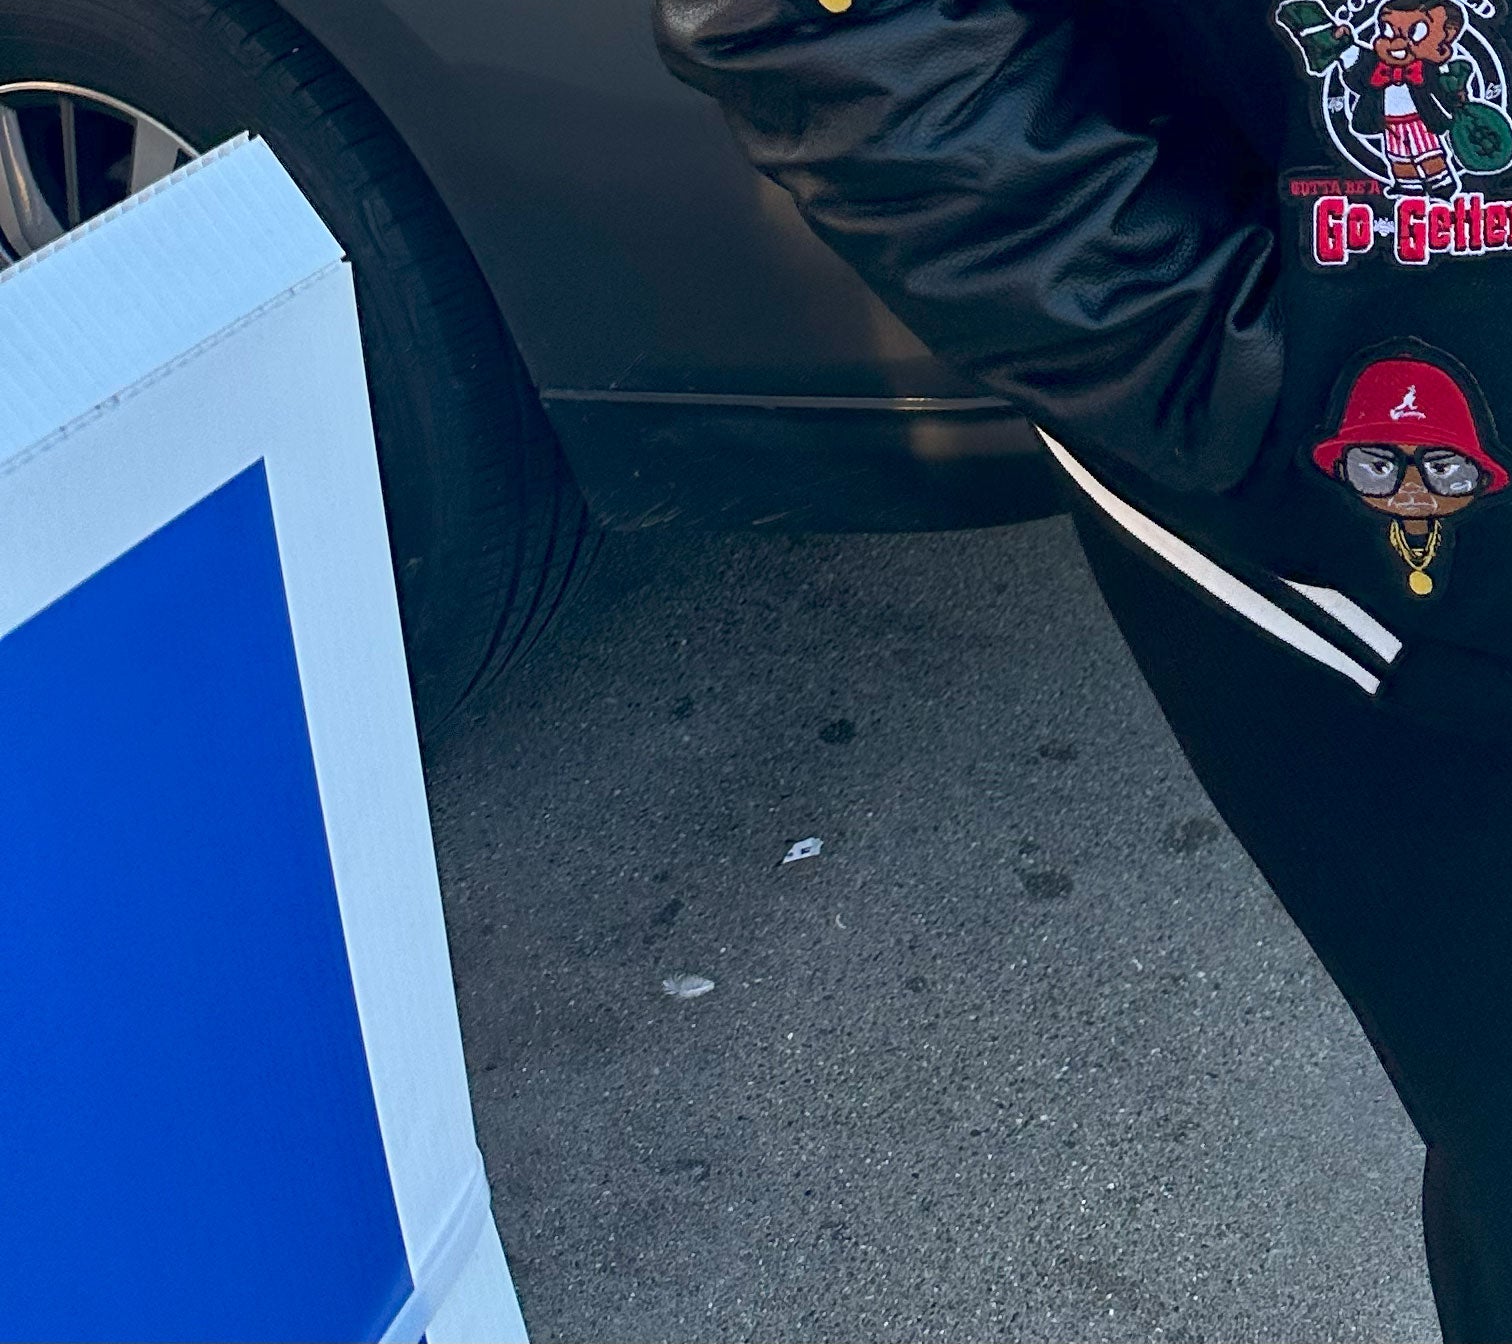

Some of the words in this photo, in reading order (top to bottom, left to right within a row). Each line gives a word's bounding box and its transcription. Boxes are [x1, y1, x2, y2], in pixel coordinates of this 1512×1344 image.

[1289, 179, 1342, 196] GOTTA
[1343, 179, 1368, 195] BE
[1367, 179, 1381, 195] A
